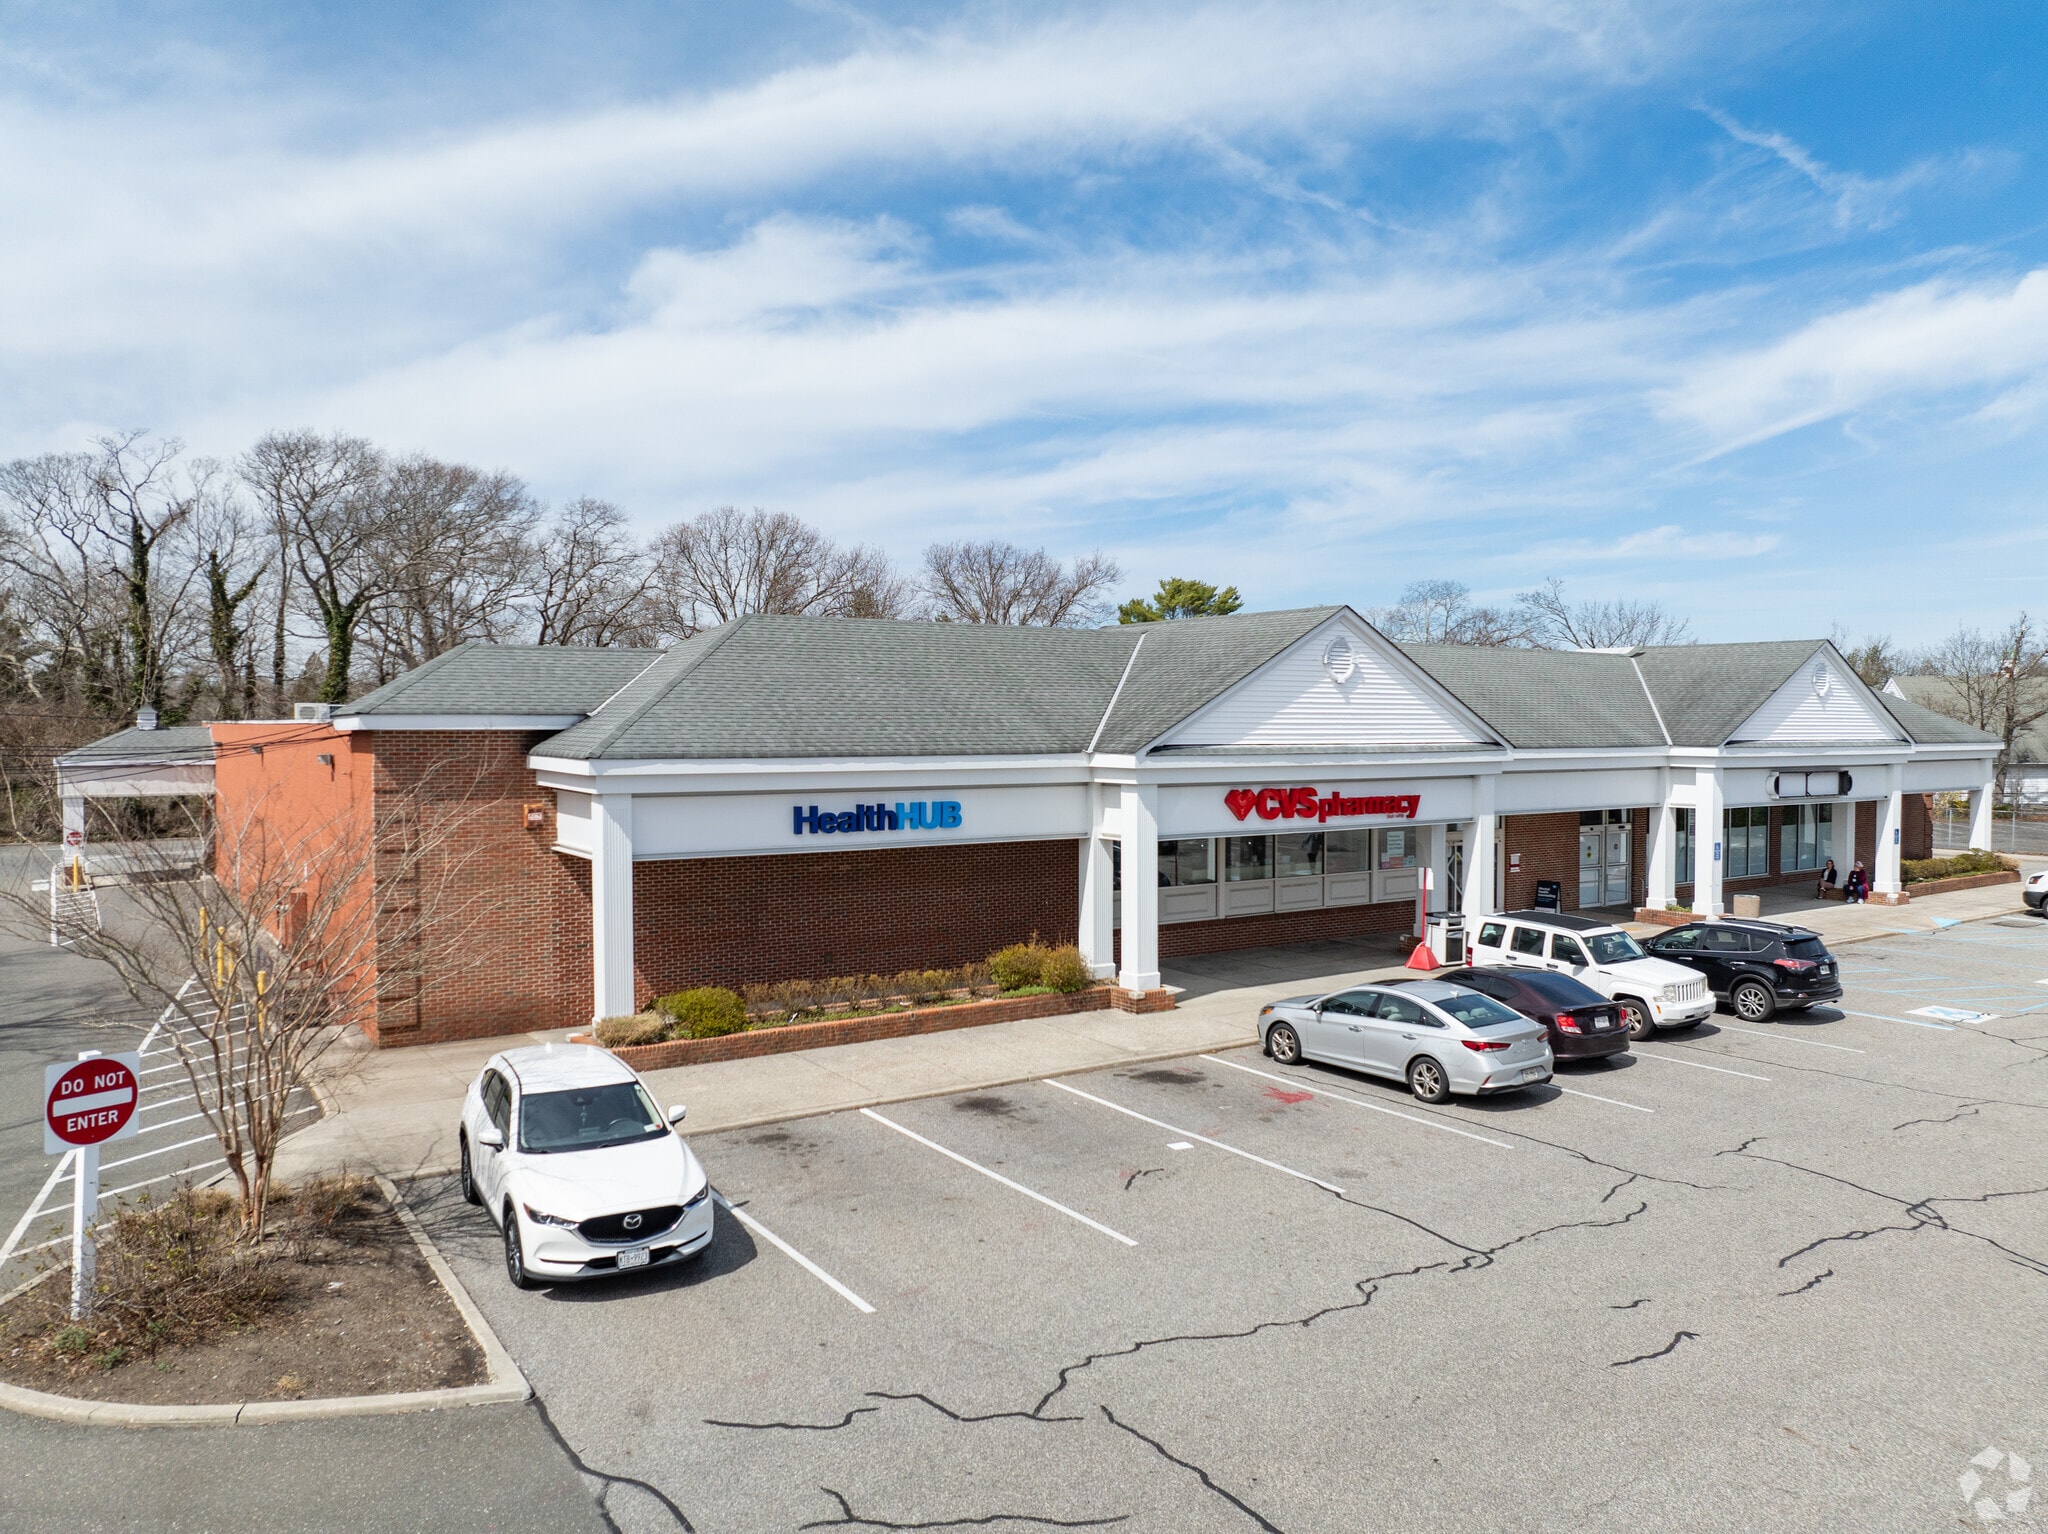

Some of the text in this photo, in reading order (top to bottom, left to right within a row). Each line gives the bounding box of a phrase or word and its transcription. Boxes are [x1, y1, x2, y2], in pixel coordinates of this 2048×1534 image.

[793, 801, 963, 835] HealthHUB
[1255, 787, 1421, 823] CVS pharmacy
[61, 1071, 126, 1095] DO NOT
[67, 1110, 118, 1132] ENTER
